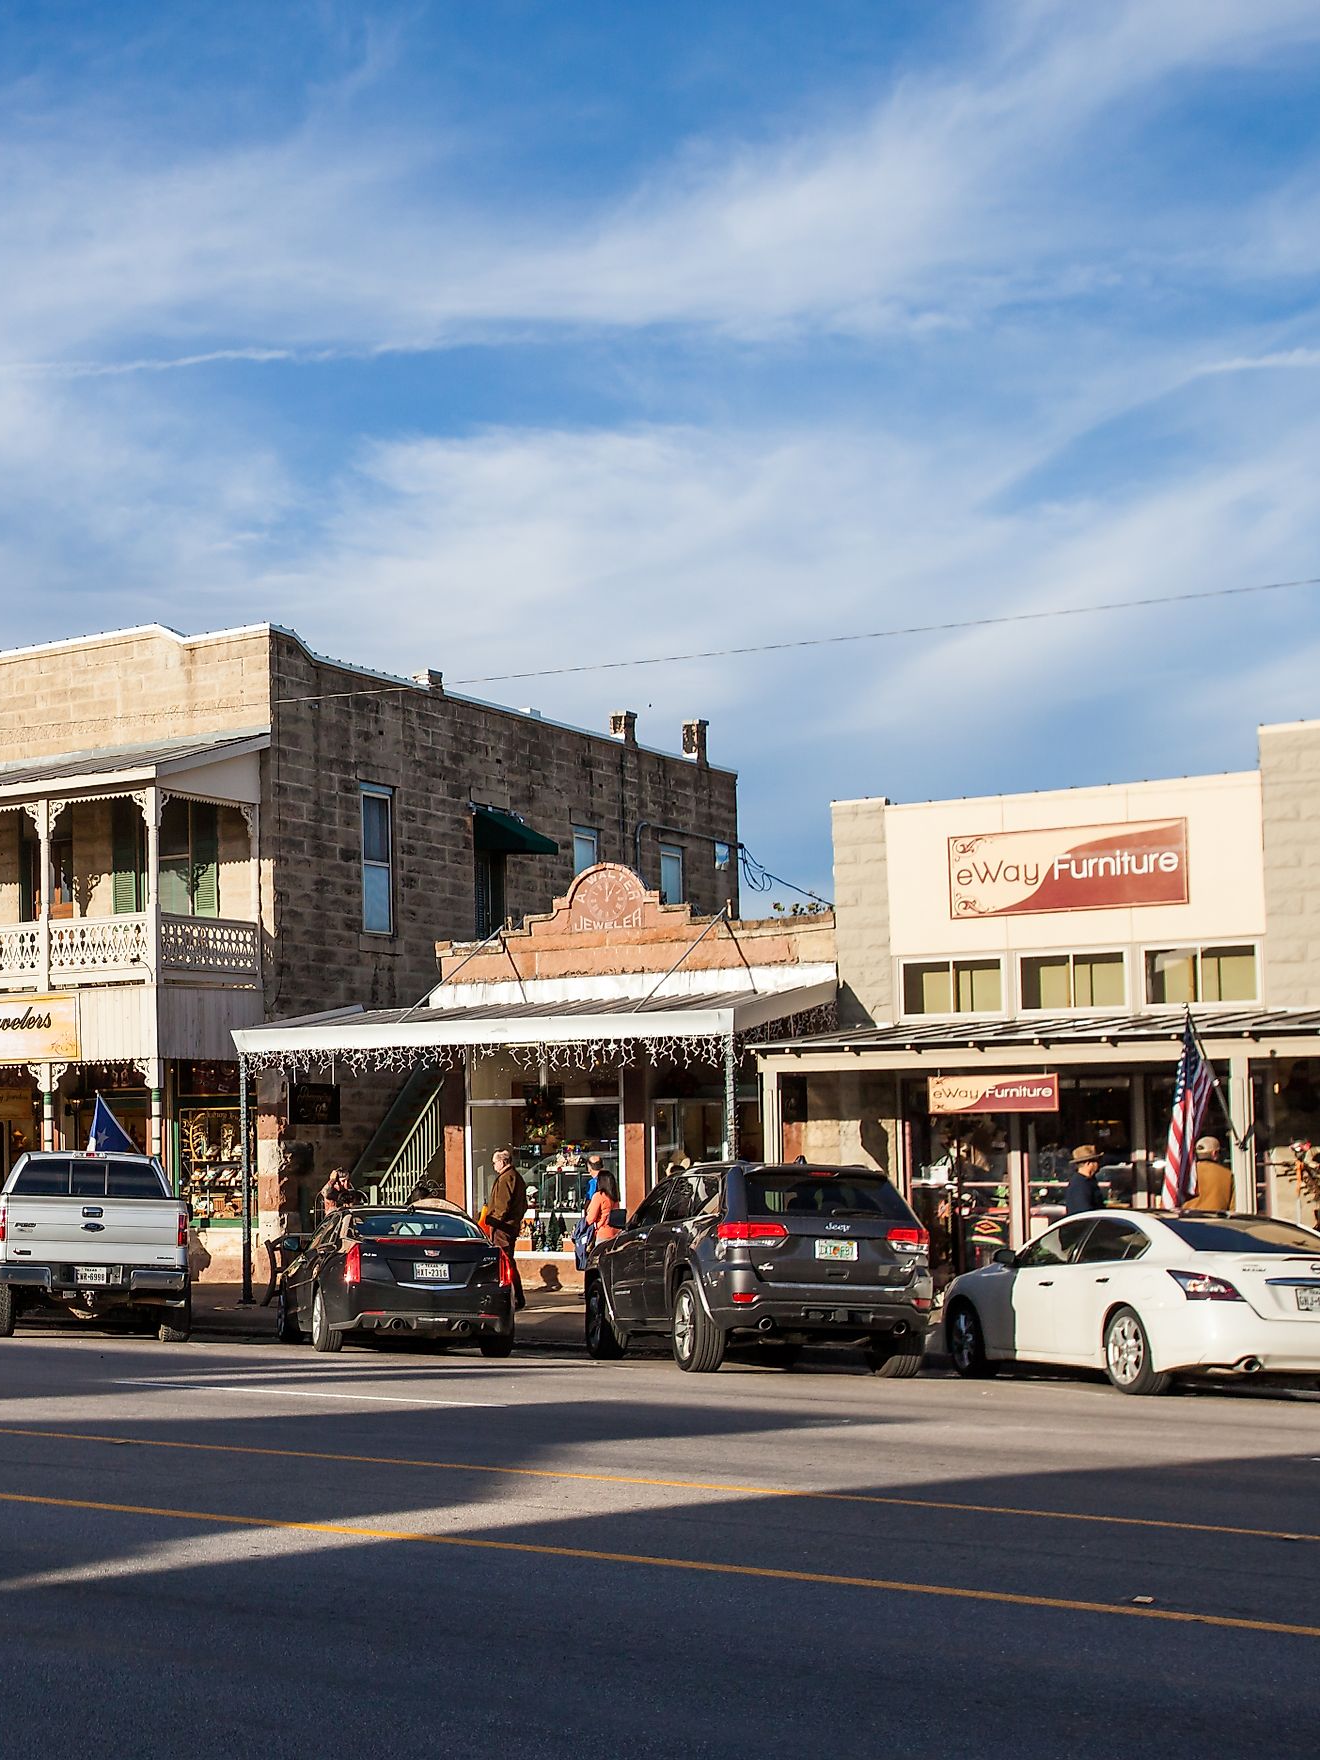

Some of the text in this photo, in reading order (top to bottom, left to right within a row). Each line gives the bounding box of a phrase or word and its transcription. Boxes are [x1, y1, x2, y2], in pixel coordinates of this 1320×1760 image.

[956, 849, 1179, 886] eWay Furniture
[586, 869, 641, 901] WALTER
[574, 907, 642, 931] JEWELER
[933, 1085, 1053, 1099] eWay Furniture
[825, 1222, 852, 1232] Jeep
